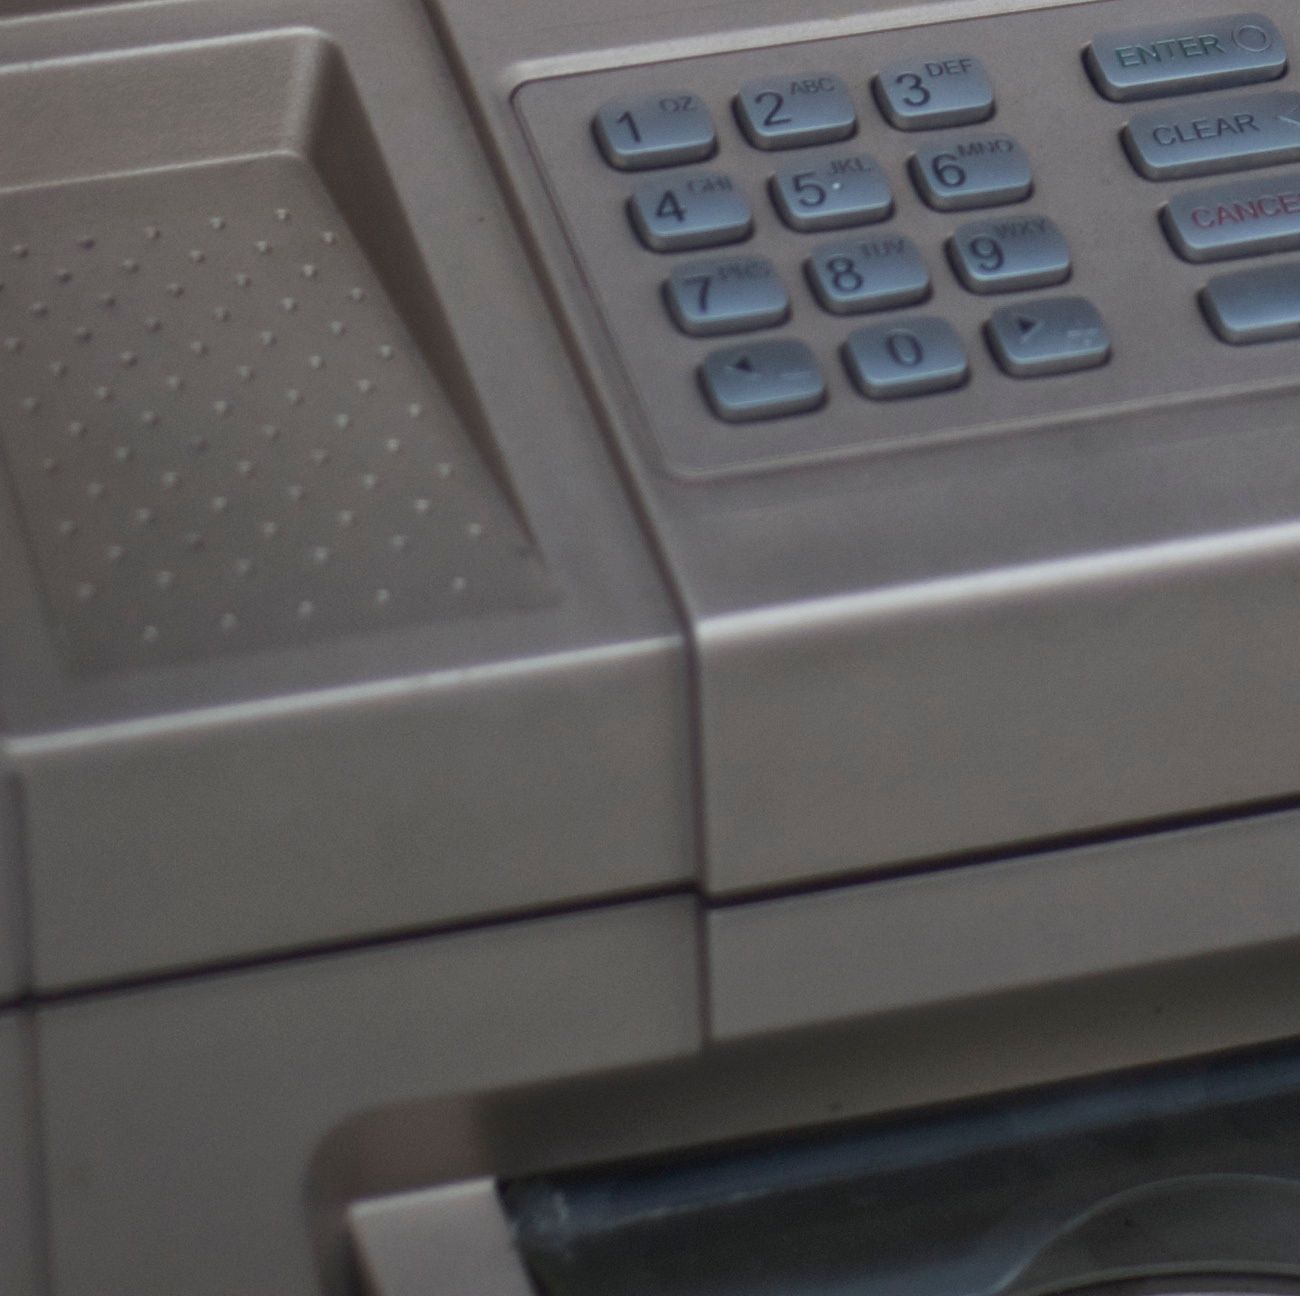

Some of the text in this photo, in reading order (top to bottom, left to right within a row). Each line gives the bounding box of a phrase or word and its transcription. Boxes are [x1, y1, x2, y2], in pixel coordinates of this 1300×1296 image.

[1115, 33, 1226, 69] ENTER
[896, 58, 974, 107] 3 DEF
[754, 77, 836, 127] 2 ABC
[617, 111, 641, 143] 1
[1152, 112, 1261, 147] CLEAR
[931, 138, 1016, 188] 6 MNO
[655, 190, 687, 223] 4
[791, 170, 827, 208] 5
[969, 236, 1005, 273] 9
[826, 258, 864, 293] 8
[682, 274, 712, 314] 7
[886, 331, 924, 367] 0
